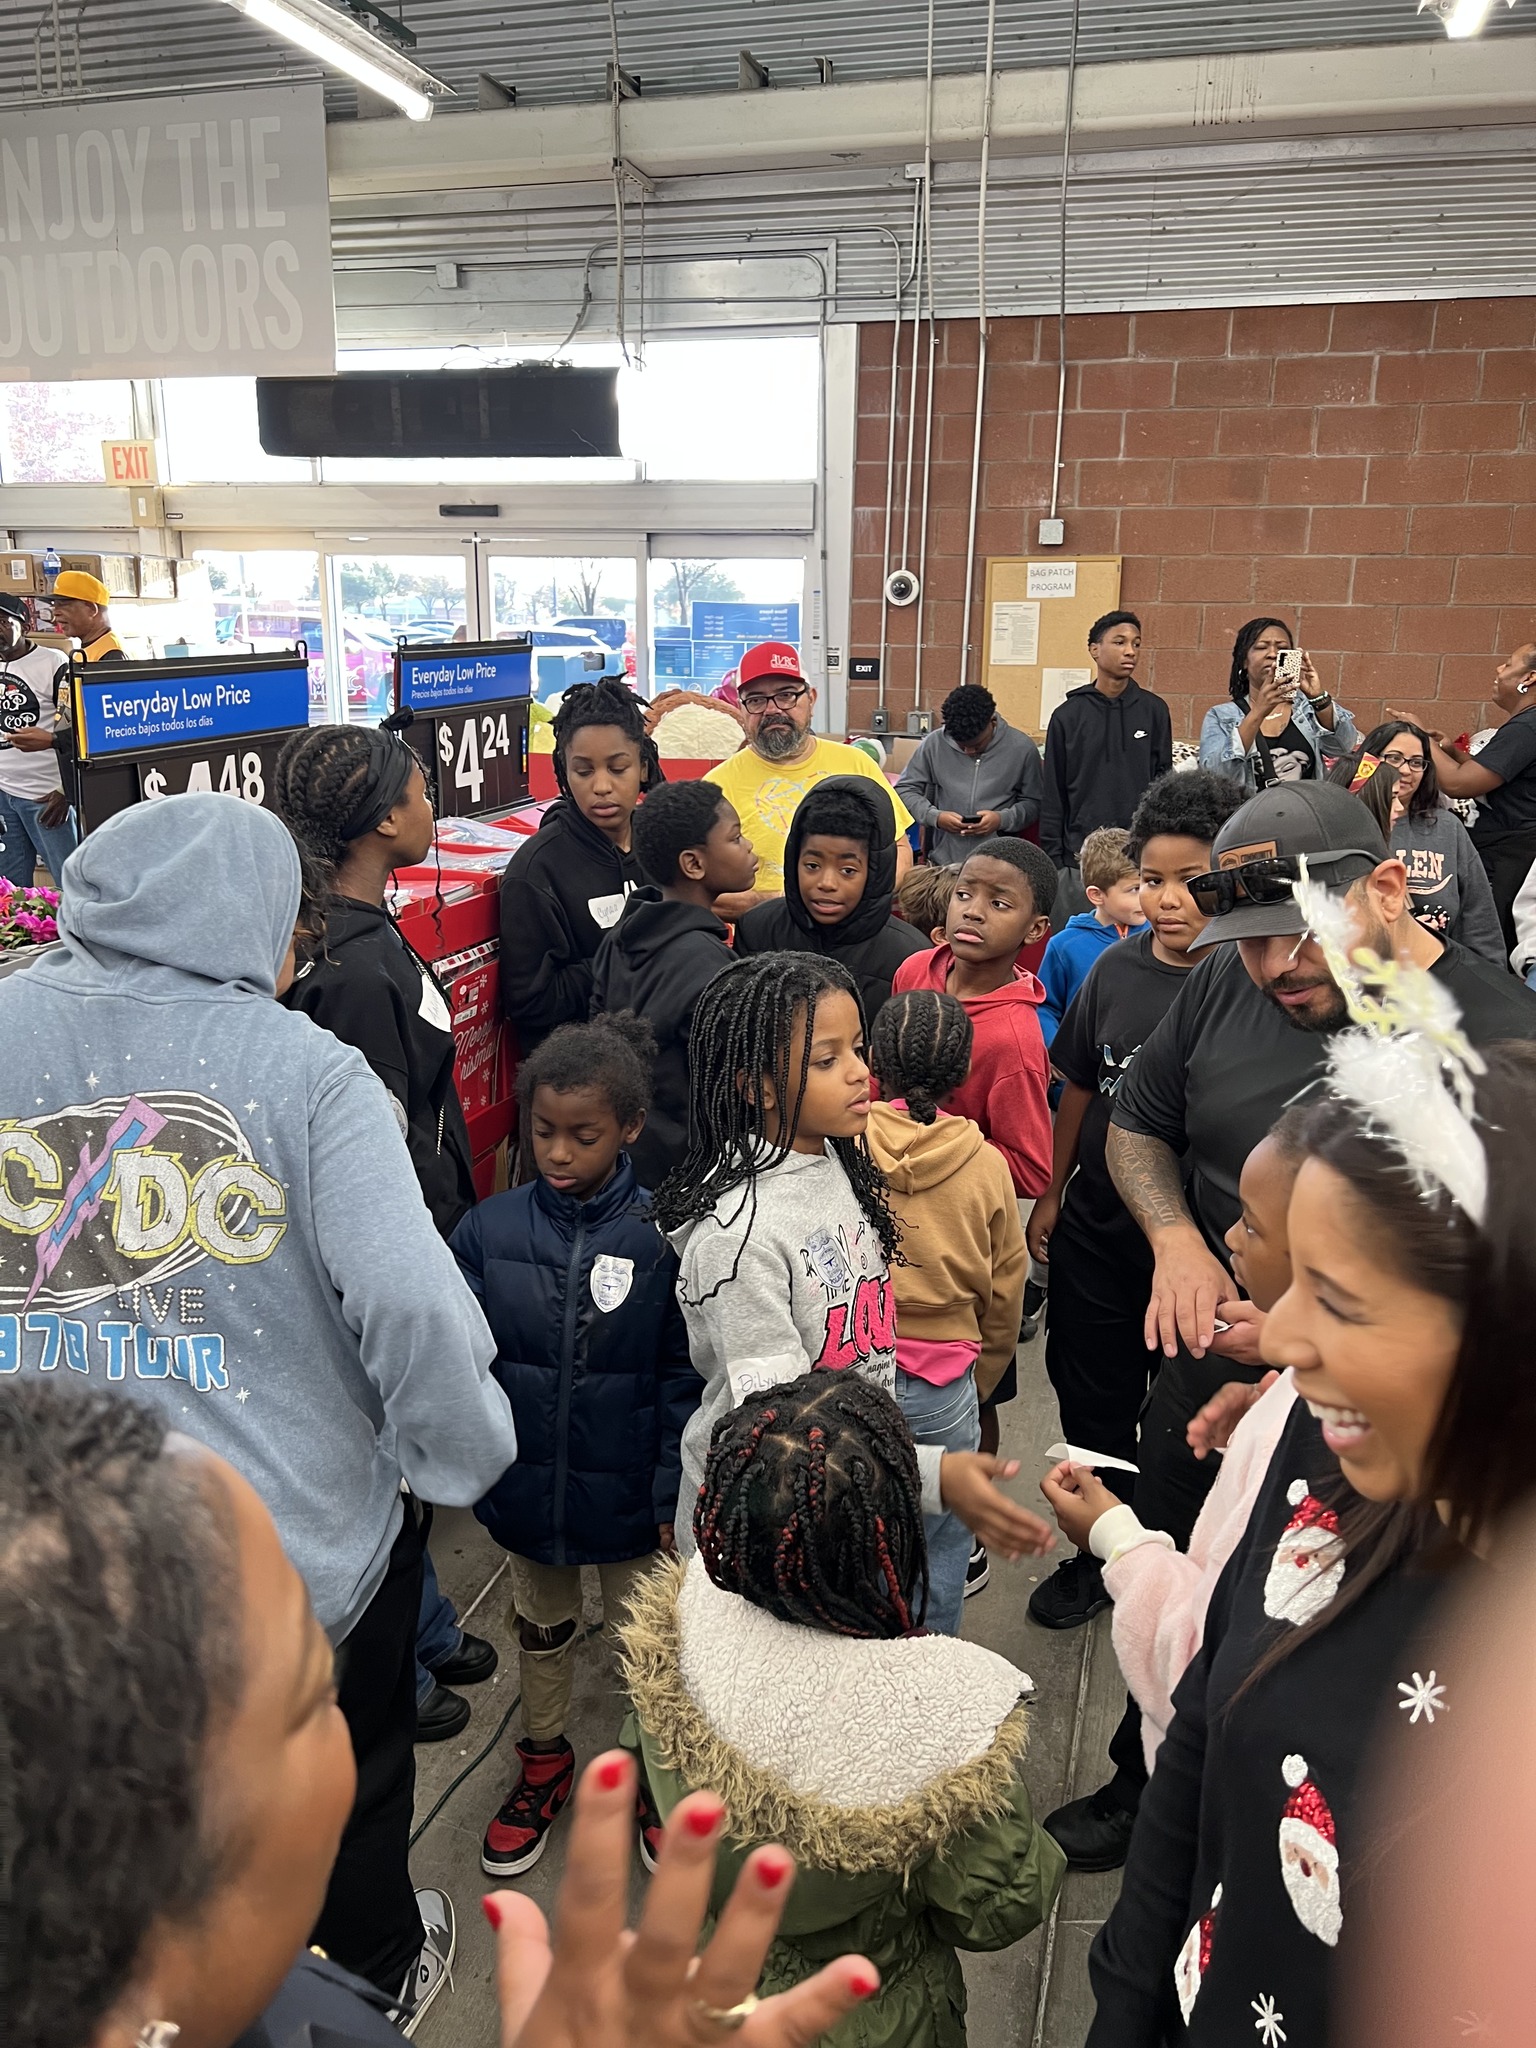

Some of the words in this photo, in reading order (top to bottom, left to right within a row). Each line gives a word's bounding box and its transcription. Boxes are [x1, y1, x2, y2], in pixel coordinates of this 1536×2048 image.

[0, 126, 151, 242] NJOY
[166, 115, 286, 232] THE
[111, 446, 149, 480] EXIT
[1030, 569, 1046, 577] BAG
[1048, 568, 1074, 577] PATCH
[1031, 583, 1072, 591] PROGRAM
[411, 665, 455, 688] Everyday
[457, 664, 474, 681] Low
[476, 662, 497, 679] Price
[855, 664, 873, 673] EXIT
[101, 690, 179, 721] Everyday
[182, 687, 212, 710] Low
[216, 684, 251, 706] Price
[411, 689, 430, 699] Precios
[105, 724, 137, 739] Precios
[138, 721, 160, 737] bajos
[161, 719, 185, 732] todos
[186, 716, 198, 728] los
[199, 714, 214, 727] días
[1395, 849, 1445, 881] LEN
[97, 1320, 230, 1392] TOUR
